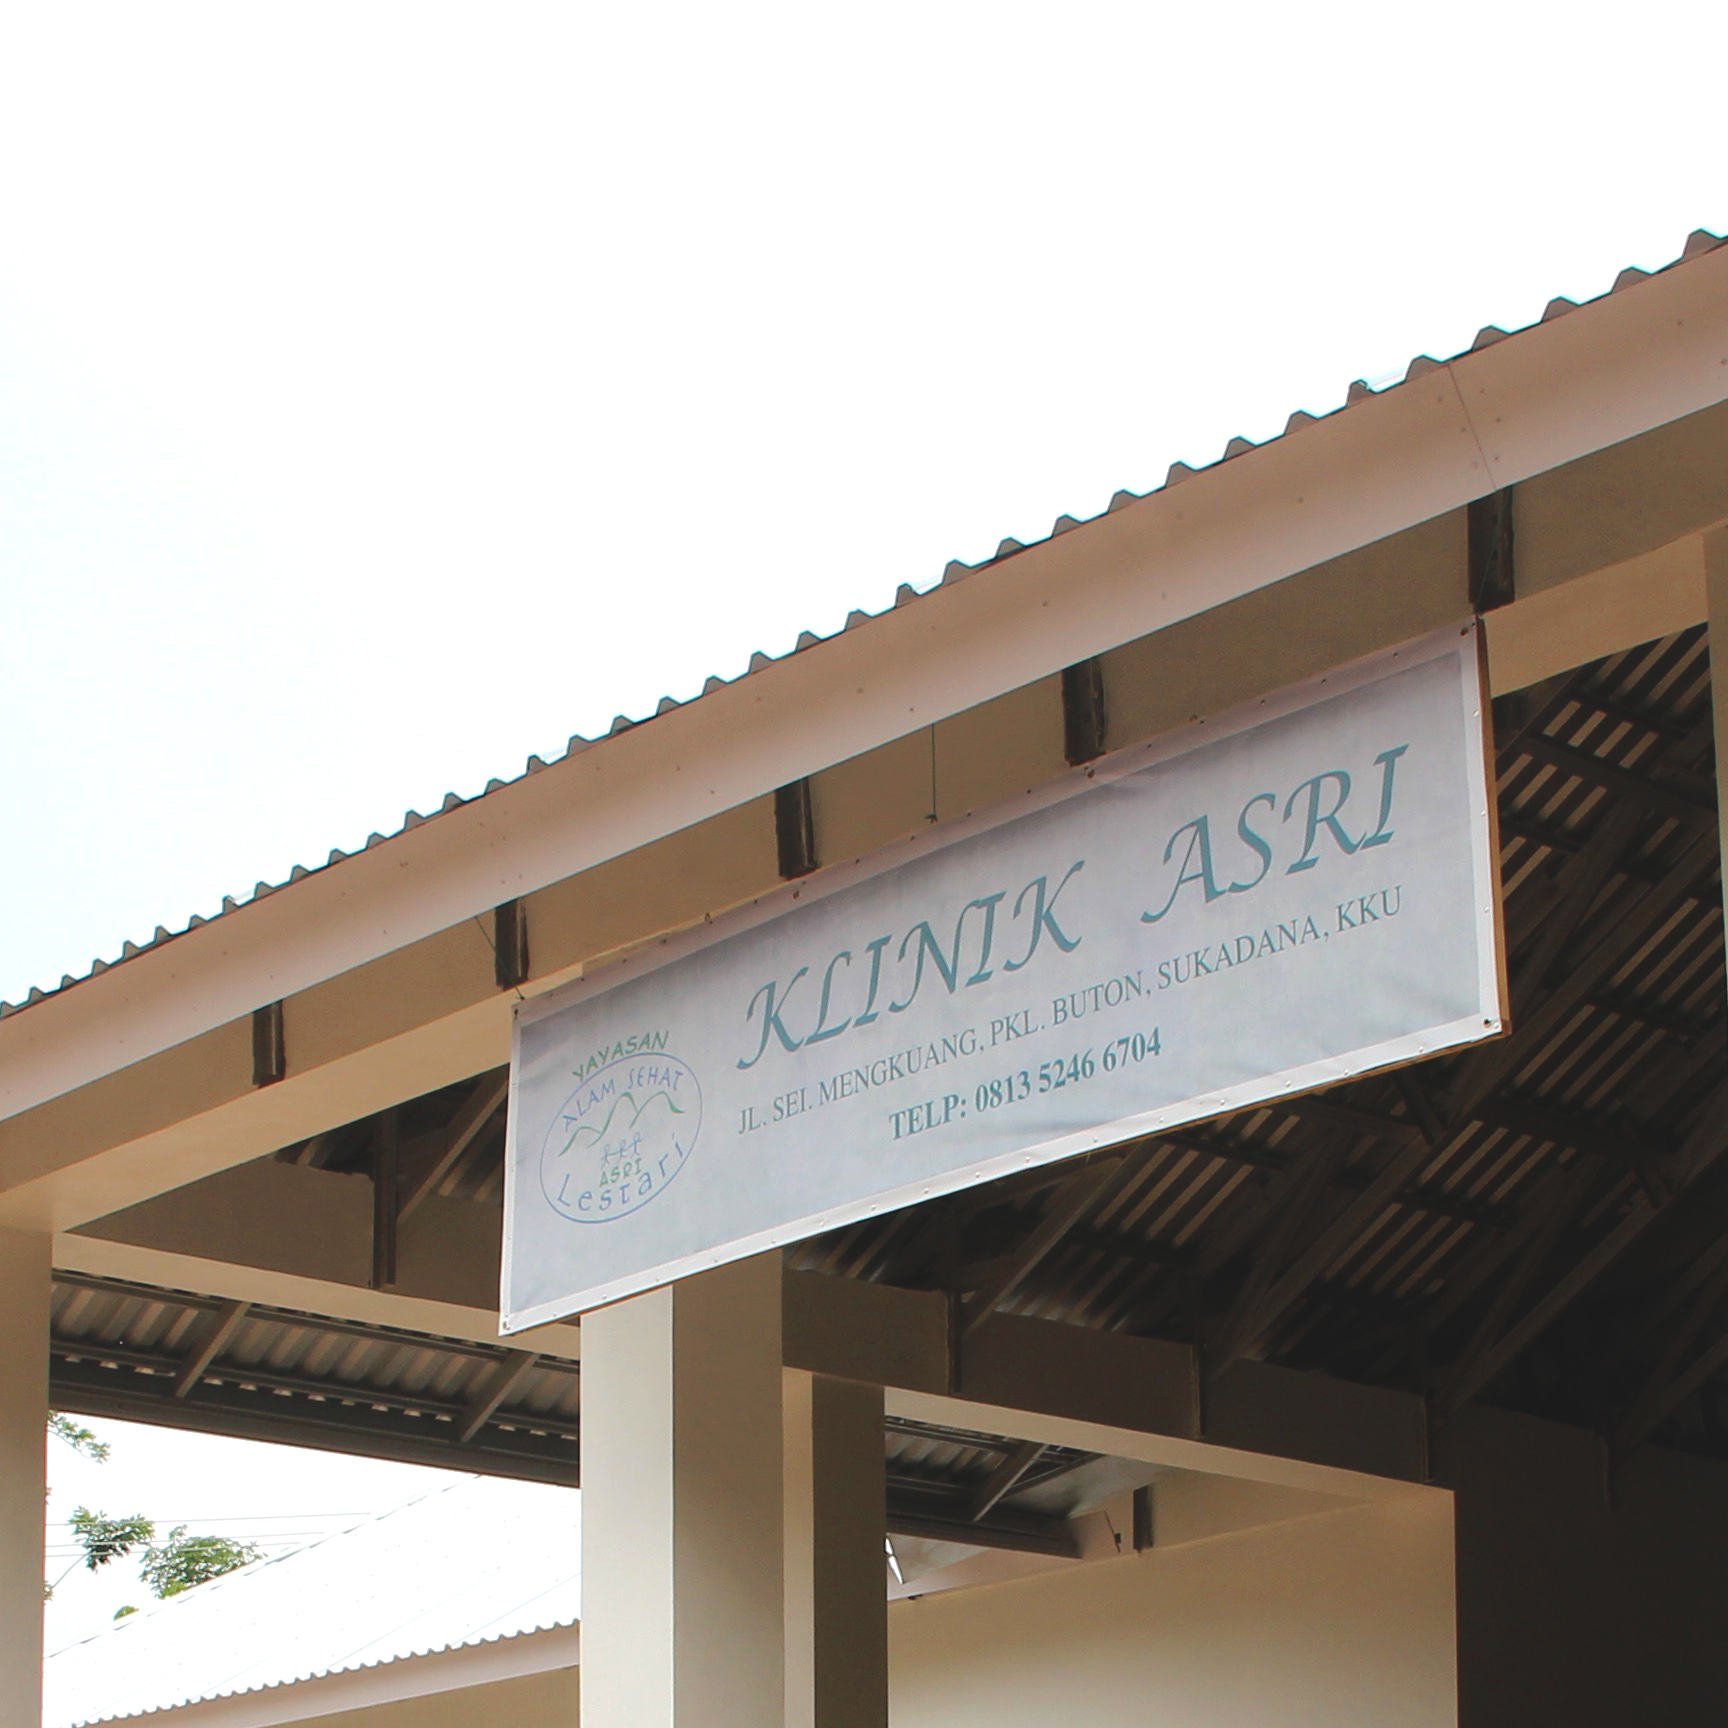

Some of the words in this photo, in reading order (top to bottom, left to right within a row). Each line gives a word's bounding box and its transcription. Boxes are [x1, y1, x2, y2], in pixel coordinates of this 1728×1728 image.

[736, 859, 1085, 1070] KLINIK
[1139, 742, 1410, 923] ASRI
[738, 1106, 767, 1135] JL.
[772, 1088, 813, 1122] SEI.
[819, 1028, 984, 1106] MENGKUANG,
[990, 1009, 1045, 1047] PKL.
[1051, 970, 1152, 1026] BUTON,
[1158, 915, 1329, 990] SUKADANA,
[1336, 884, 1403, 933] KKU
[572, 1030, 669, 1083] YAYASAN
[888, 1091, 967, 1140] TELP:
[975, 1070, 1031, 1113] 0813
[1038, 1047, 1095, 1094] 5246
[1101, 1026, 1163, 1074] 6704
[562, 1078, 617, 1133] ALAM
[628, 1066, 684, 1091] SEHAT
[557, 1132, 683, 1212] Lestari
[599, 1157, 643, 1188] ASRI
